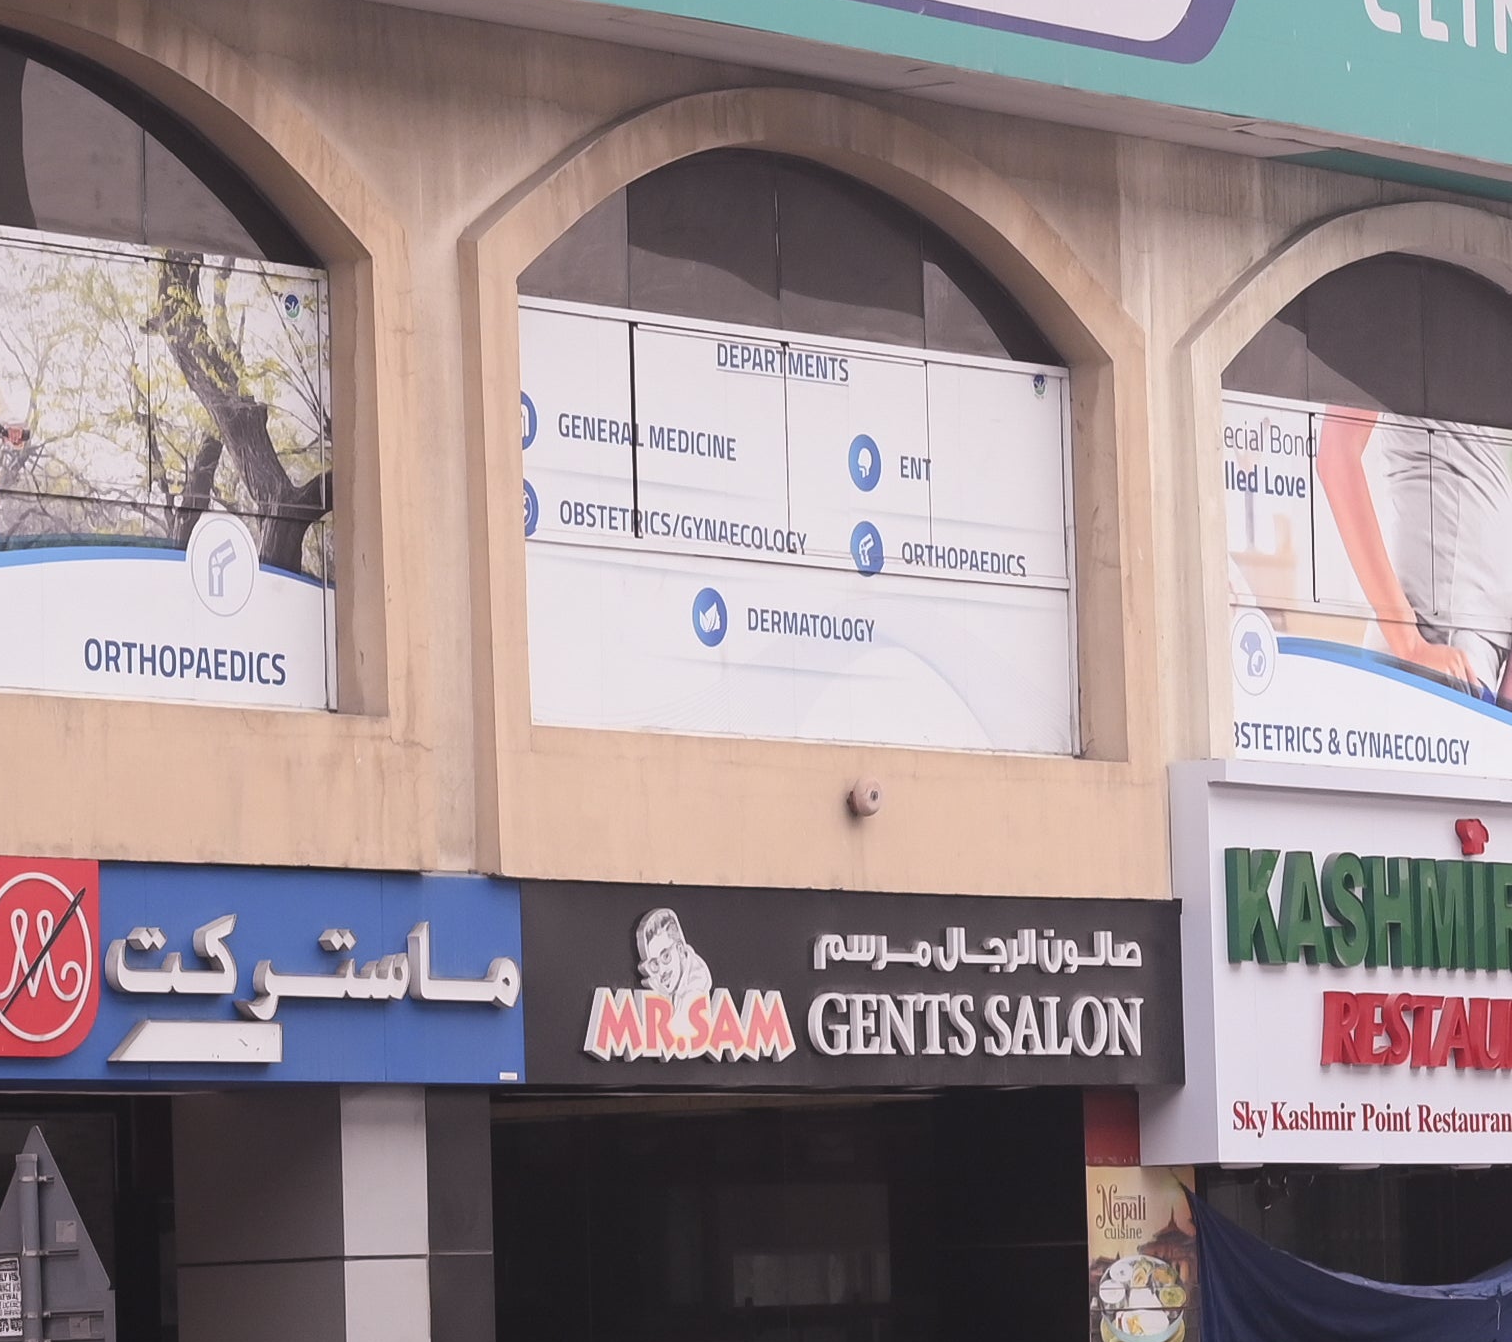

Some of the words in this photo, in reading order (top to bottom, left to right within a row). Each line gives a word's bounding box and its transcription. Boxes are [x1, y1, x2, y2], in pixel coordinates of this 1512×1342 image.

[716, 343, 850, 383] DEPARTMENTS
[558, 413, 644, 447] GENERAL
[649, 425, 737, 462] MEDICINE
[1224, 422, 1265, 453] ecial
[1270, 425, 1318, 459] Bond
[900, 455, 931, 481] ENT
[1224, 460, 1259, 494] lled
[1264, 464, 1306, 499] Love
[901, 542, 1027, 577] ORTHOPAEDICS
[747, 607, 875, 643] DERMATOLOGY
[84, 637, 287, 686] ORTHOPAEDICS
[1328, 730, 1342, 757] &
[1345, 732, 1470, 767] GYNAECOLOGY
[931, 927, 1037, 973] الرجال
[1038, 928, 1143, 974] صالون
[807, 992, 977, 1057] GENTS
[984, 994, 1144, 1057] SALON
[1232, 1101, 1267, 1138] Sky
[1271, 1101, 1356, 1134] Kashmir
[1361, 1103, 1412, 1134] Point
[1096, 1183, 1146, 1229] Nepali
[1104, 1224, 1143, 1240] cuisine
